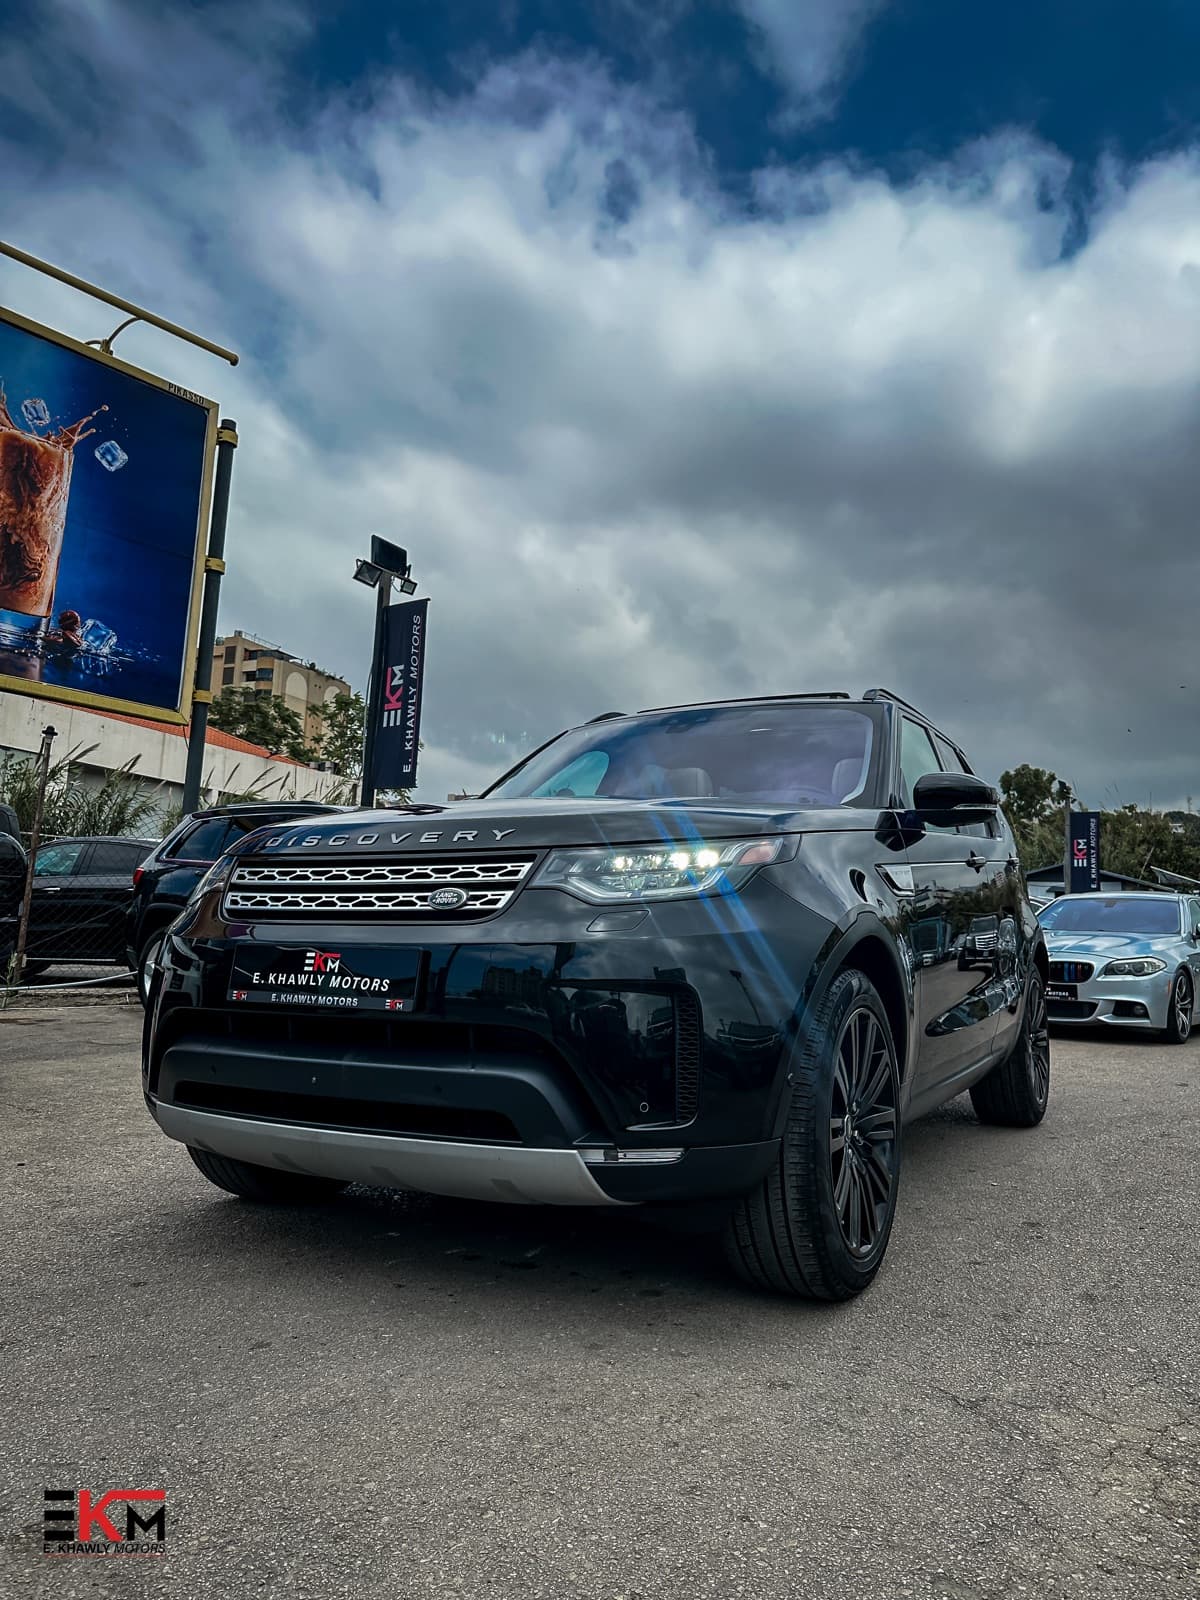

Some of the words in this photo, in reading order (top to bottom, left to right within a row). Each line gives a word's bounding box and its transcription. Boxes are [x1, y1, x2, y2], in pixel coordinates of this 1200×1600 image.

[410, 615, 421, 679] MOTORS
[382, 664, 405, 728] EKM
[404, 686, 417, 750] KHAWLY
[403, 758, 412, 773] E.
[265, 829, 516, 847] DISCOVERY
[304, 952, 341, 973] EKM
[252, 972, 265, 984] E.
[268, 973, 325, 987] KHAWLY
[329, 975, 390, 992] MOTORS
[271, 993, 279, 1002] E.
[280, 994, 317, 1004] KHAWLY
[318, 996, 358, 1007] MOTORS
